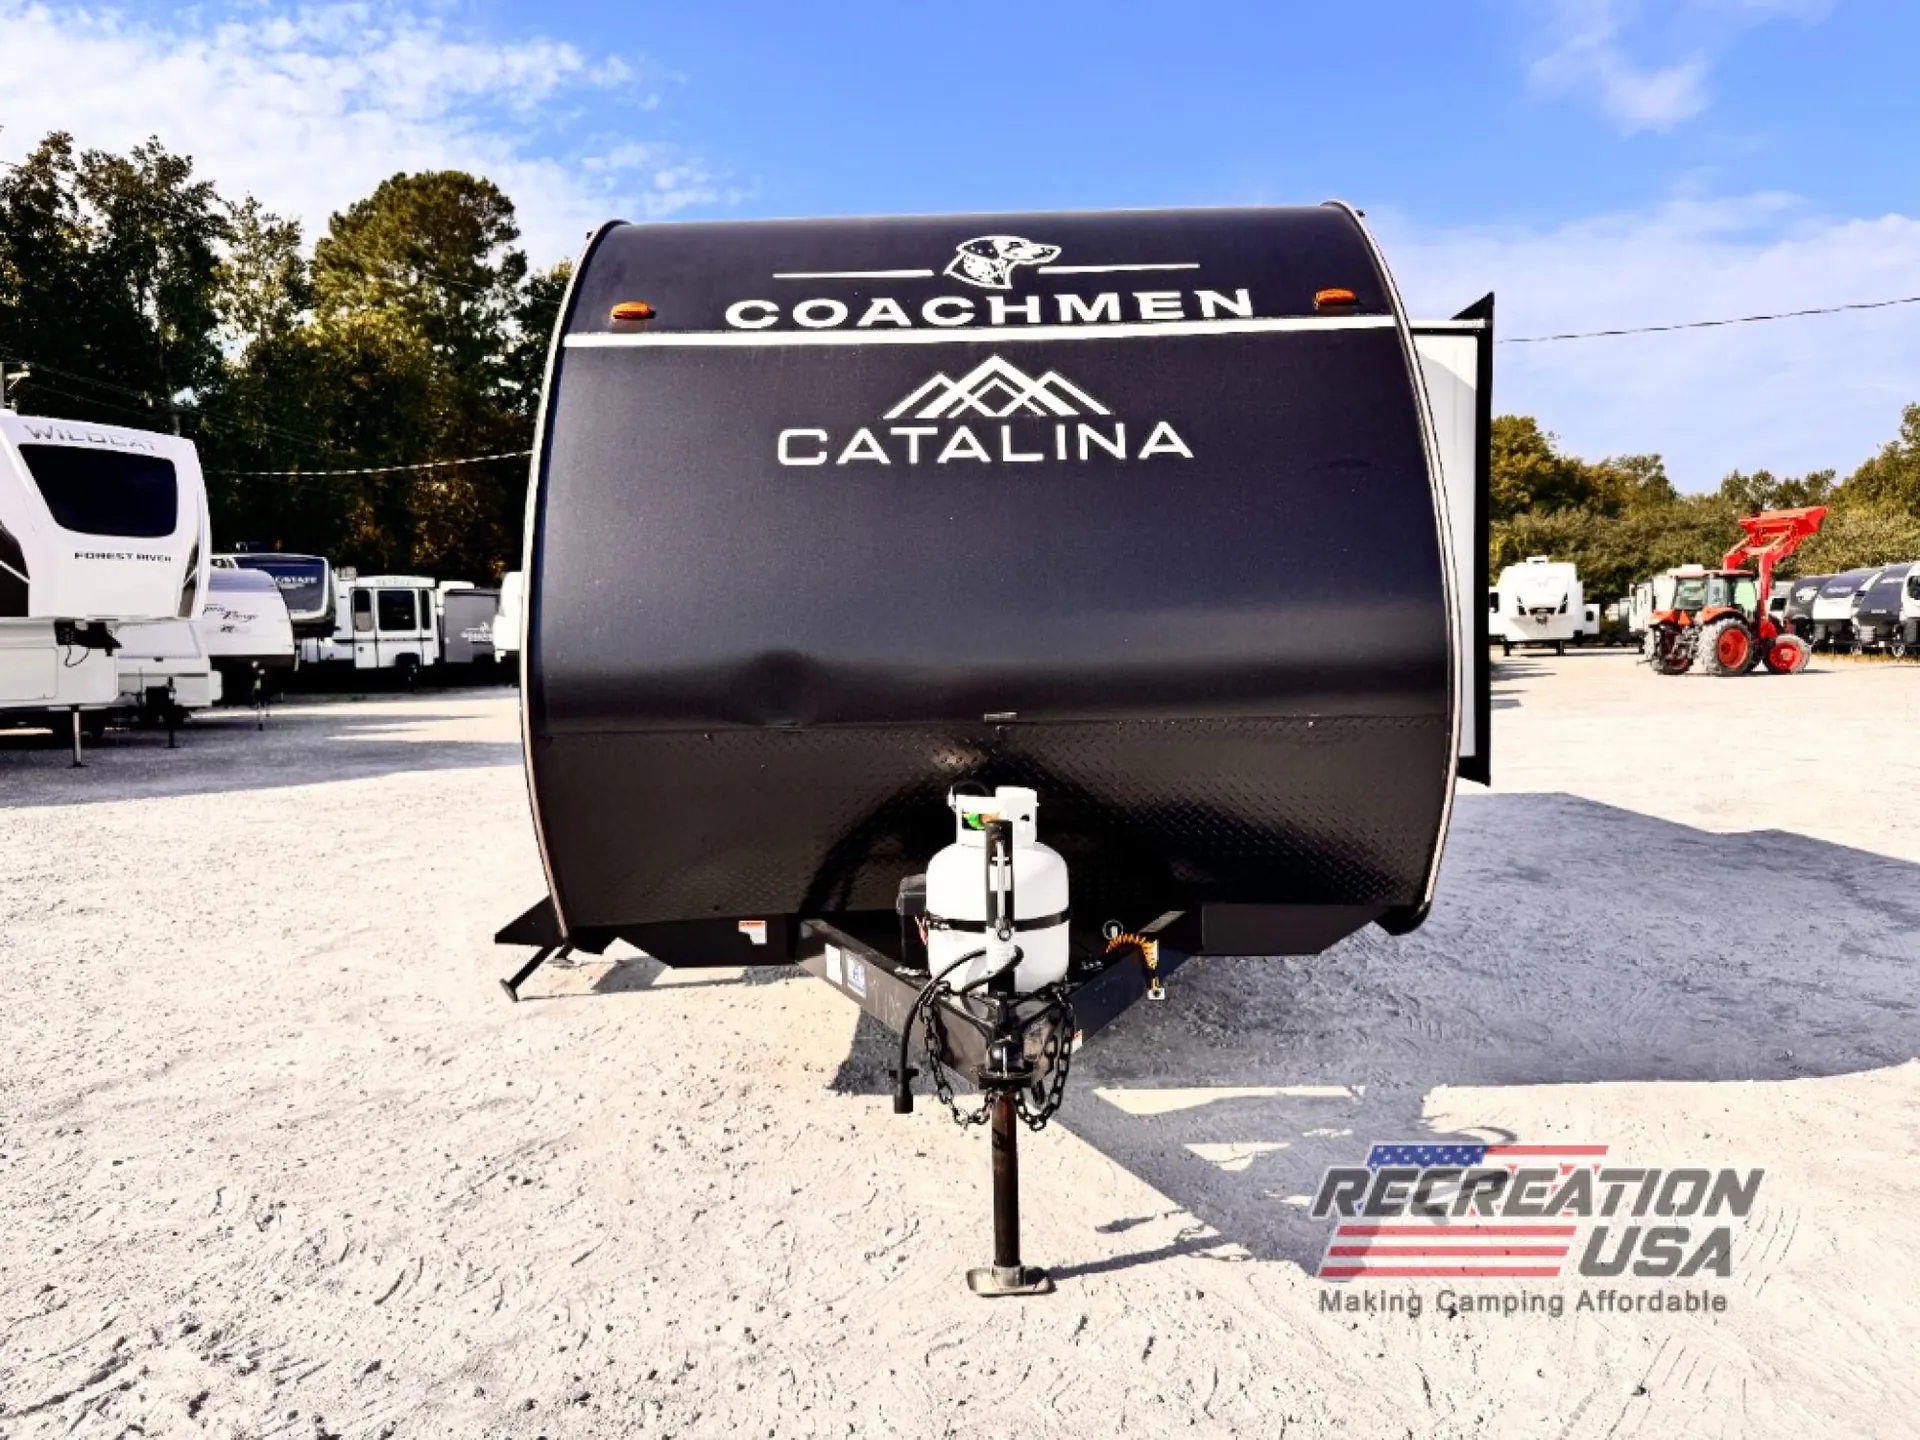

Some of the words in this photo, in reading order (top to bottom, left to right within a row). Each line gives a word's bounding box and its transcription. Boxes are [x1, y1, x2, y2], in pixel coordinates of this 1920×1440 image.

[725, 288, 1254, 329] COACHMEN
[24, 424, 156, 450] WILDCAT
[777, 421, 1195, 466] CATALINA
[74, 552, 133, 561] FOREST
[136, 553, 172, 562] RIVER
